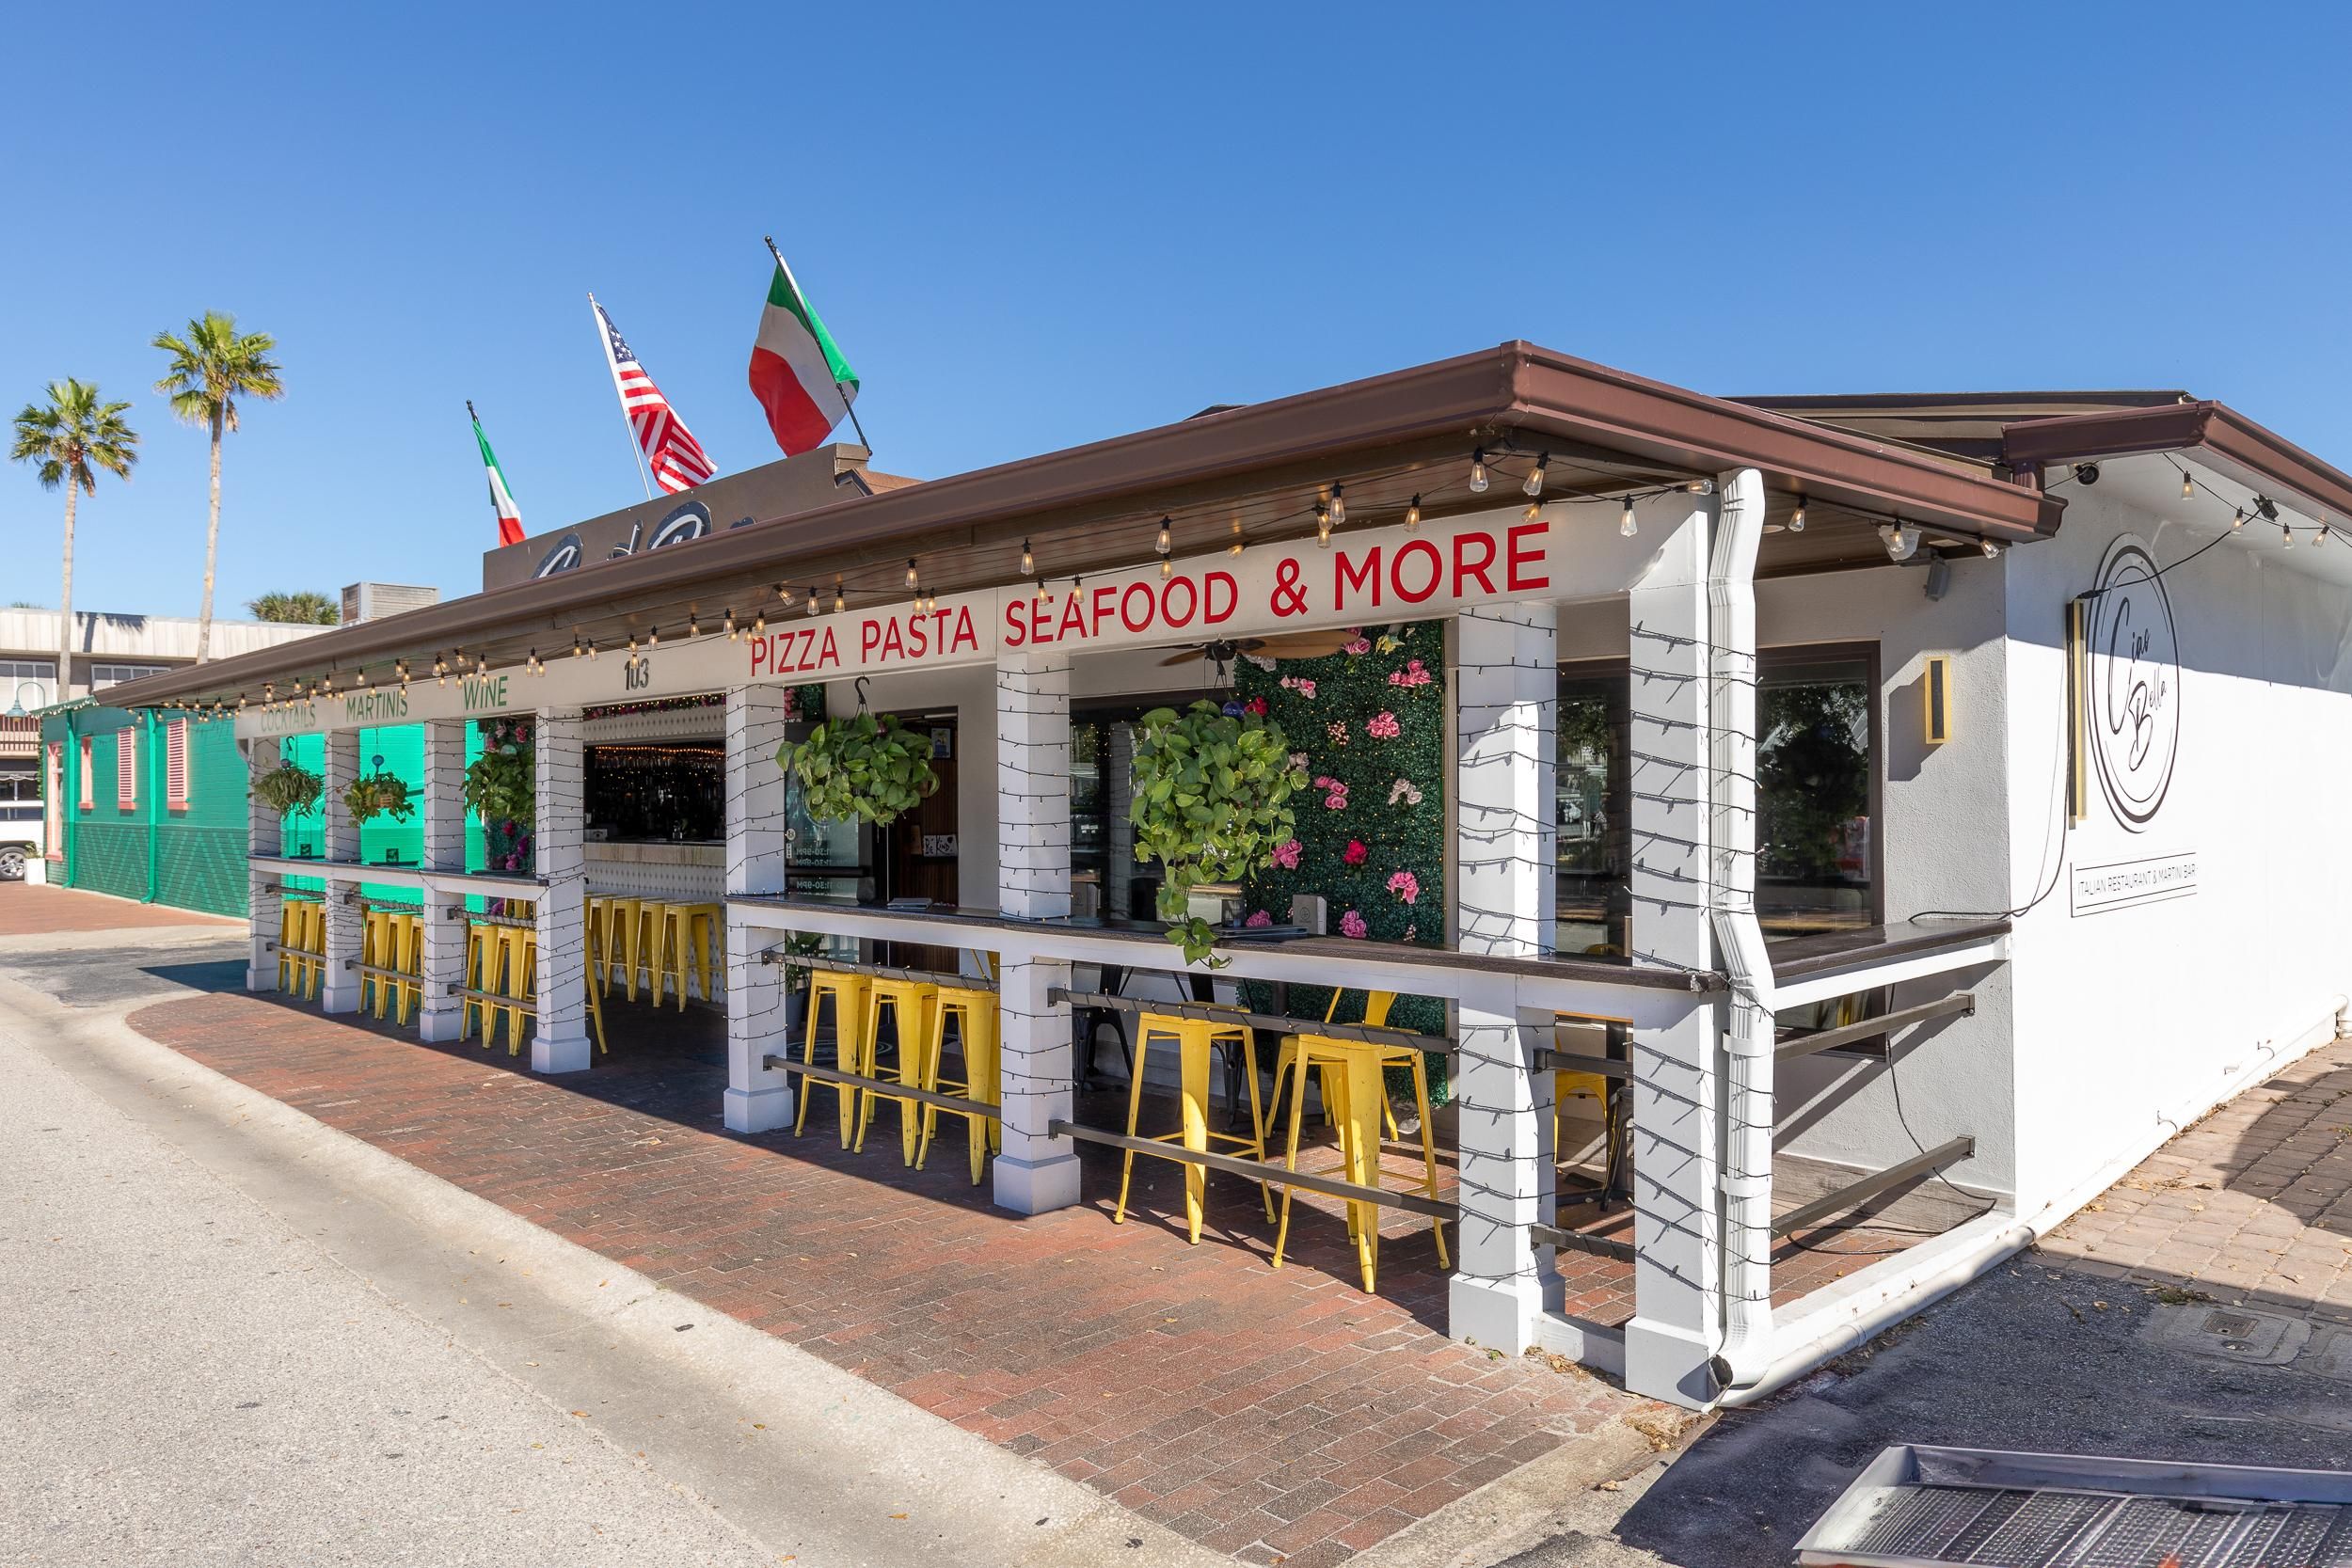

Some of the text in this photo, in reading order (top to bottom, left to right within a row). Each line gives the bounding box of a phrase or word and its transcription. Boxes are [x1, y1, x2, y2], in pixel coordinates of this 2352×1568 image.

[751, 521, 1550, 677] PIZZA PASTA SEAFOOD & MORE
[624, 657, 650, 690] 103
[2107, 596, 2151, 736] Ciao
[261, 675, 509, 732] COCKTAILS MARTINIS WINE
[2077, 879, 2106, 896] ITALIAN
[2107, 871, 2152, 892] RESTAURANT
[2158, 865, 2183, 882] MARTINI
[2184, 863, 2196, 879] BAR
